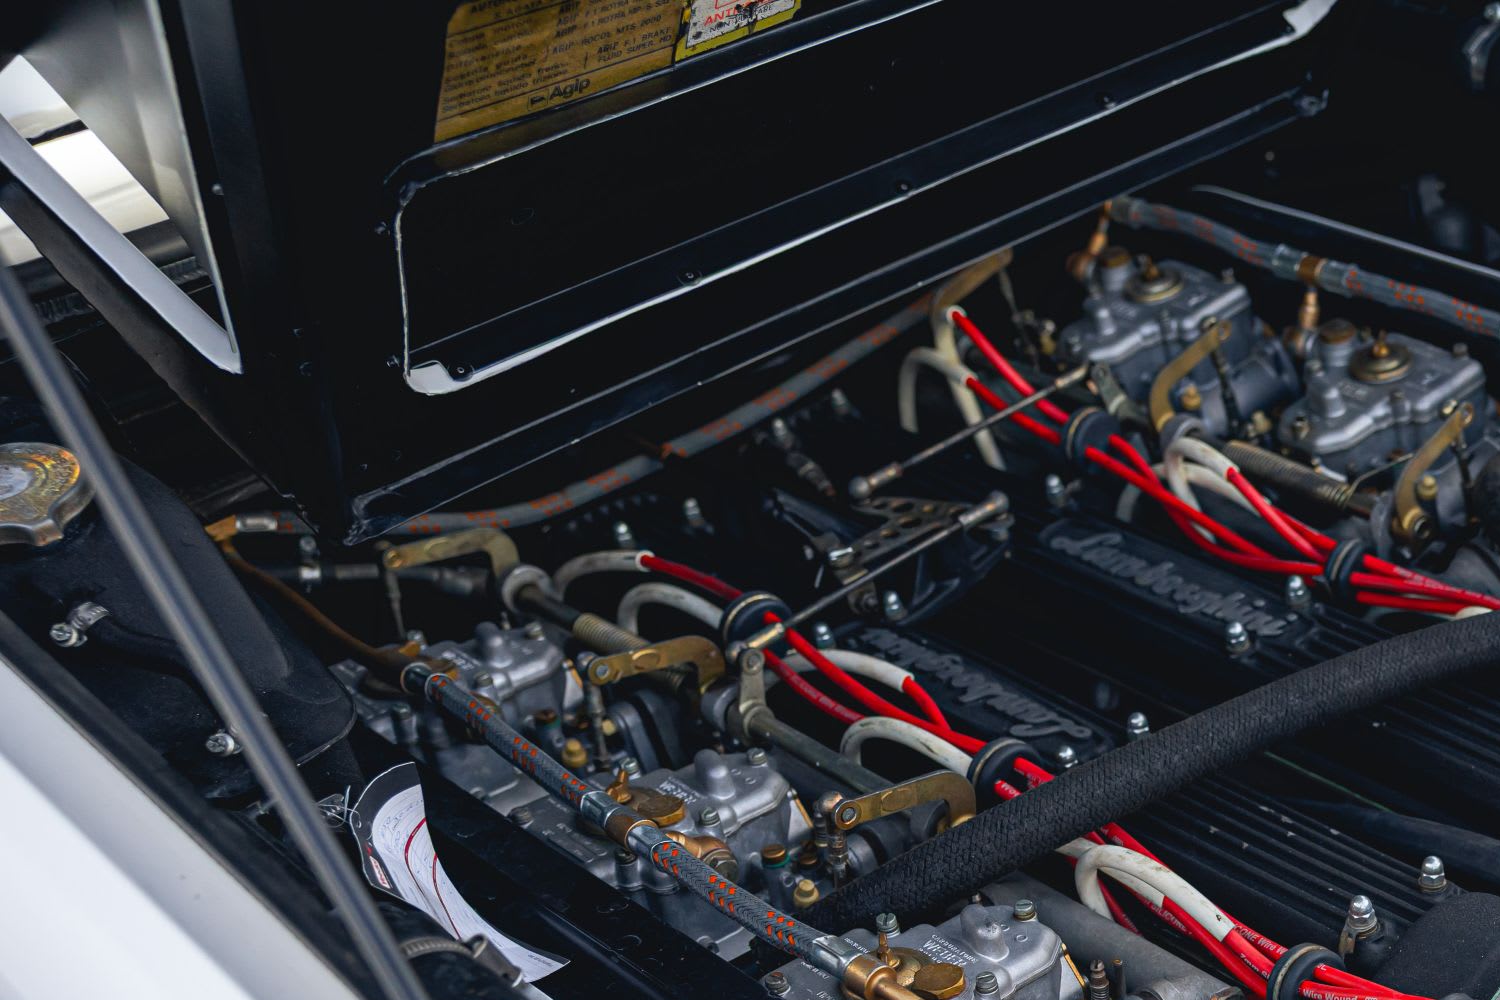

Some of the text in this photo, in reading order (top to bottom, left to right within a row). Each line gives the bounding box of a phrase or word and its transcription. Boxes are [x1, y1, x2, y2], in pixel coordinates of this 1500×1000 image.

[550, 78, 591, 101] Agip
[1050, 532, 1298, 639] Lamborghini
[923, 939, 967, 967] WEBER
[1302, 988, 1323, 1000] Wire
